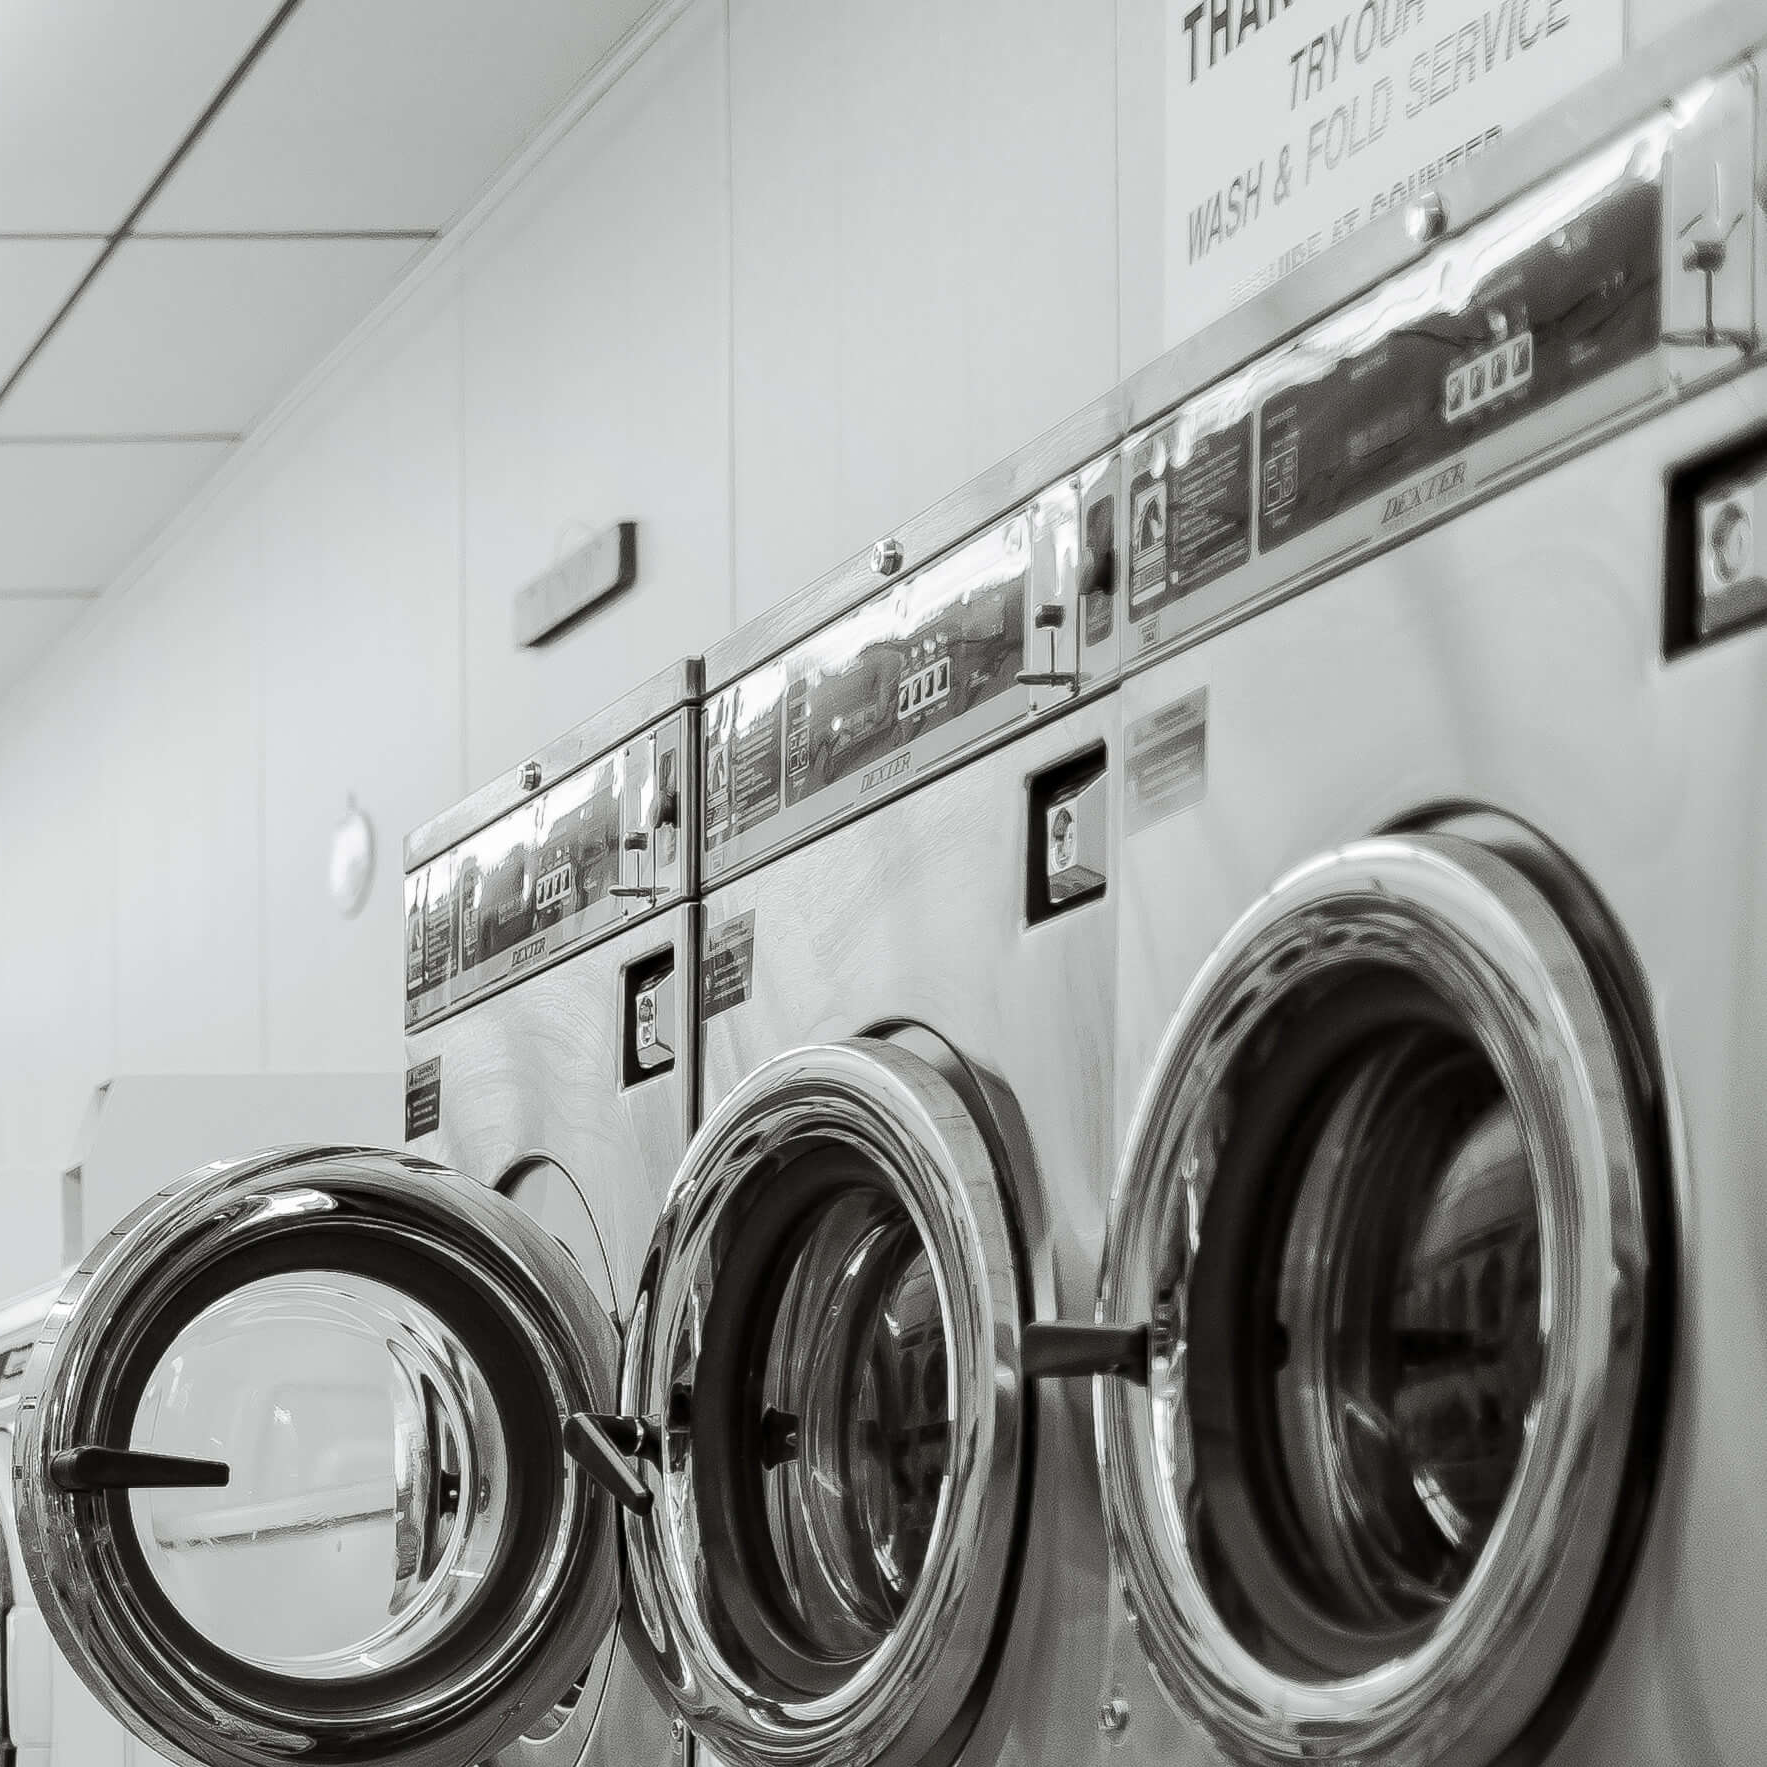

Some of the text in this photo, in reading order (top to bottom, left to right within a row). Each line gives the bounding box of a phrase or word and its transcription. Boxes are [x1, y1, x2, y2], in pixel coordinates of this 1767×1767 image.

[1183, 0, 1293, 85] THA
[1289, 14, 1350, 111] TRY
[1187, 159, 1265, 266] WASH
[1273, 143, 1292, 208] &
[1304, 75, 1395, 187] FOLD
